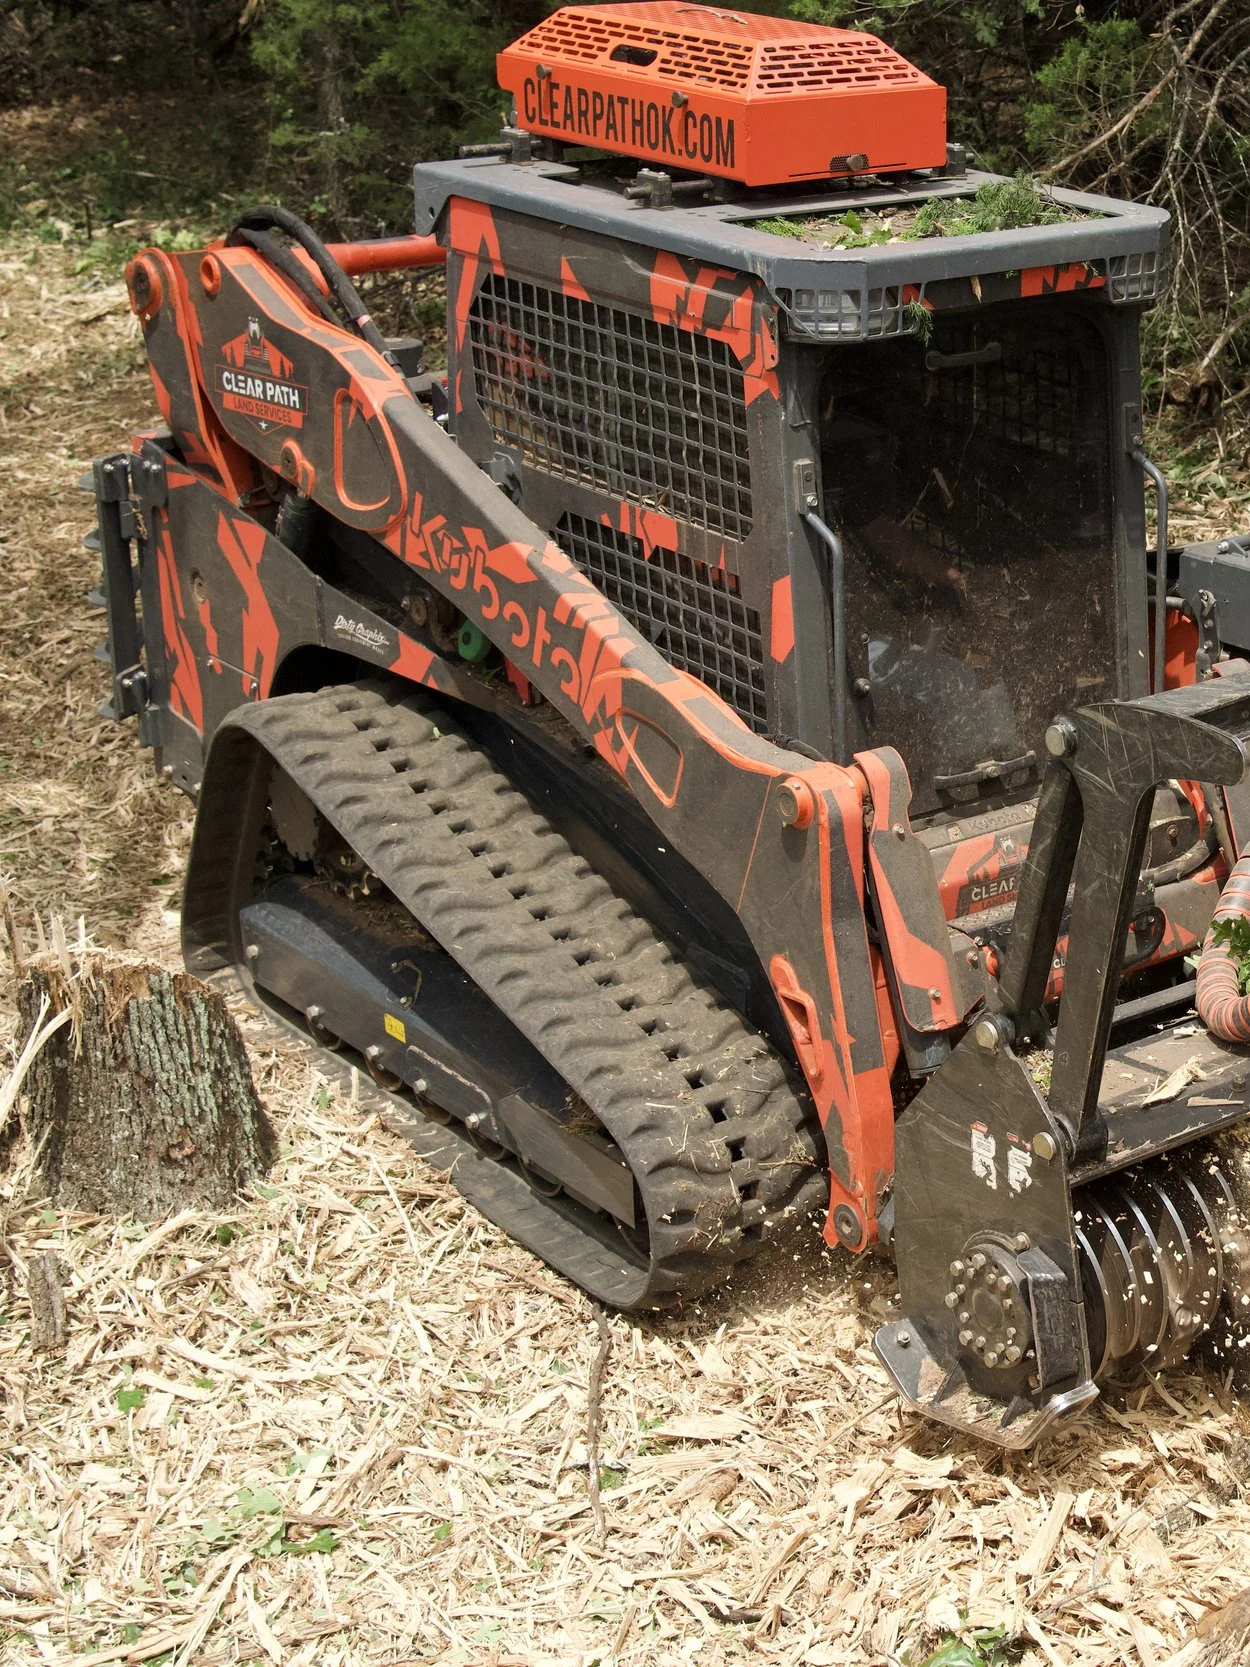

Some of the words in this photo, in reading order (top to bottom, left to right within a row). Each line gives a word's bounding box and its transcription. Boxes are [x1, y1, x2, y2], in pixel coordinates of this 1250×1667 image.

[523, 77, 736, 169] CLEARPATHOK.COM
[222, 371, 264, 400] CLEAR
[265, 382, 300, 409] PATH
[233, 396, 254, 413] LAND
[255, 403, 292, 424] SERVICES
